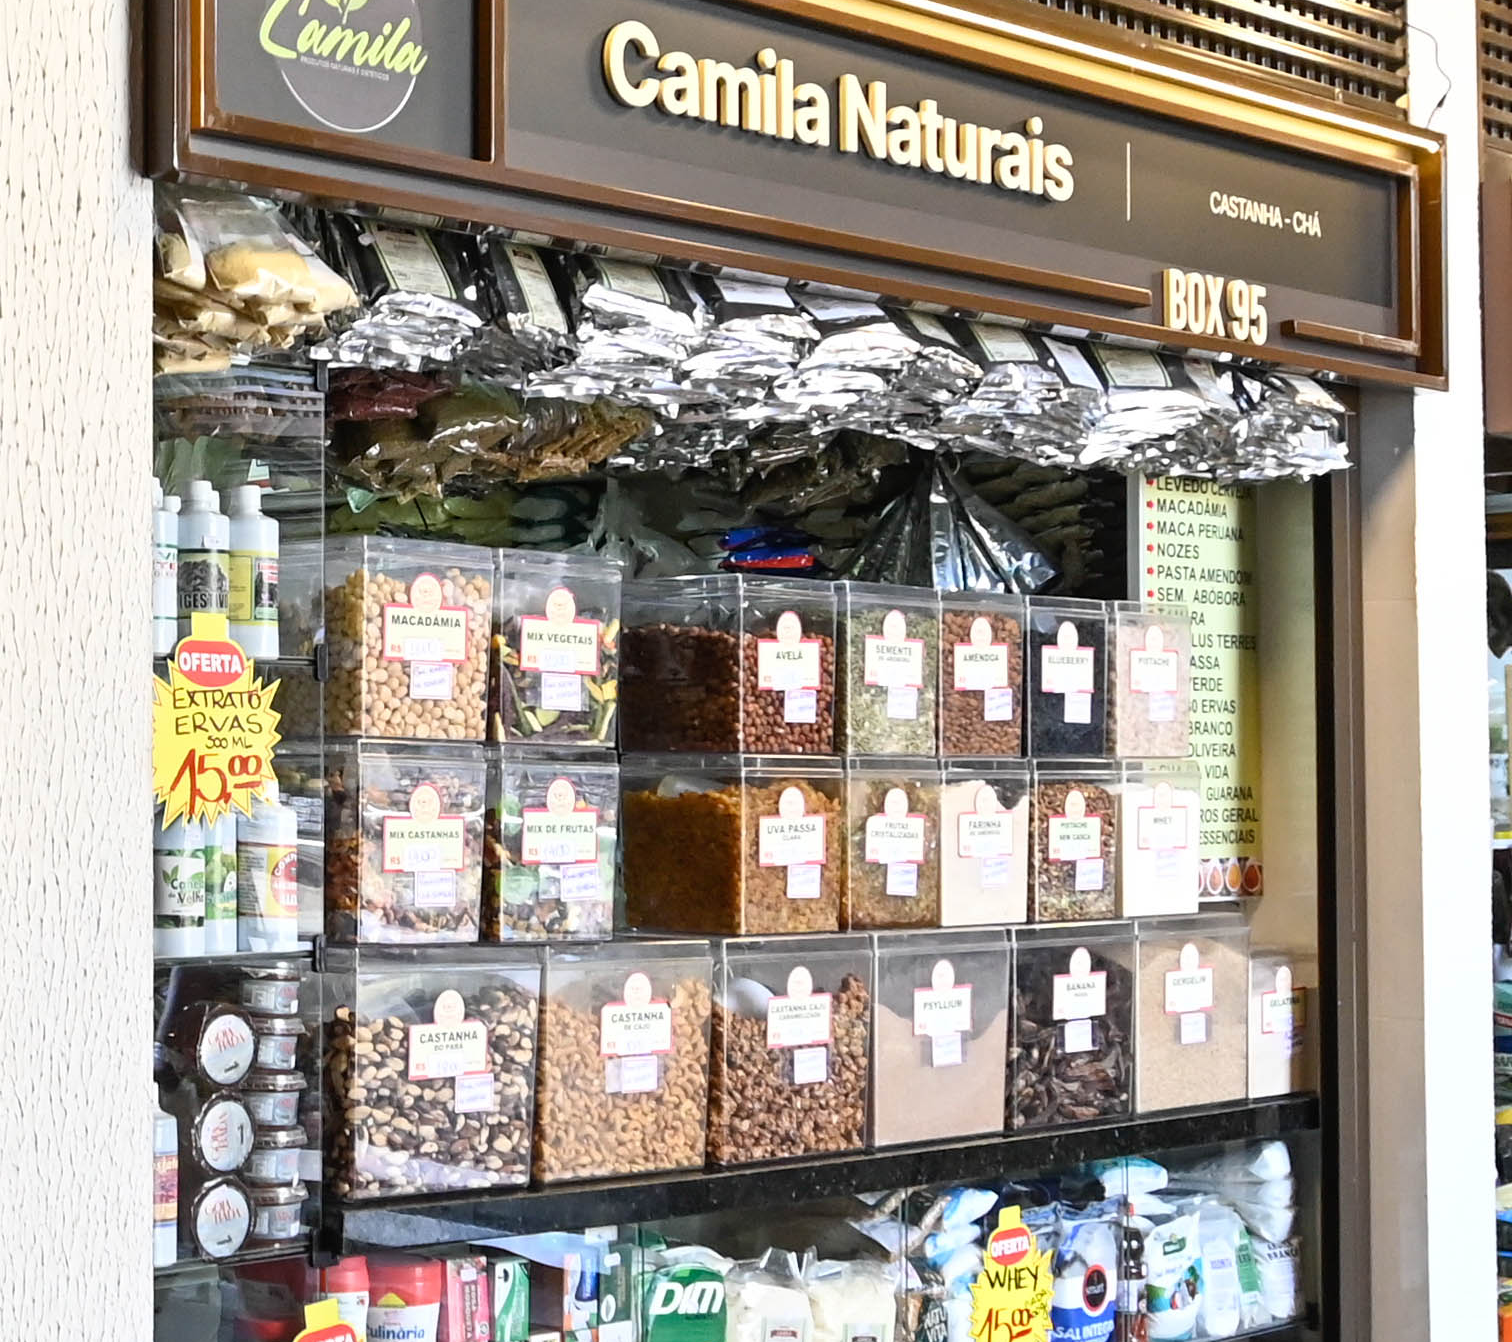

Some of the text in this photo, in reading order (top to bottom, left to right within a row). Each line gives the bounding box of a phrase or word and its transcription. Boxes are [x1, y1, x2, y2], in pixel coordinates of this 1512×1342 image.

[604, 20, 1074, 202] Camila Naturais
[1210, 191, 1322, 239] CASTANHA CHÁ
[1163, 268, 1268, 347] BOX 95
[1157, 475, 1208, 494] LEVEDO
[1157, 521, 1245, 542] MACA PERUANA
[1157, 543, 1200, 559] NOZES
[1157, 565, 1196, 581] PASTA
[179, 592, 229, 610] IGESTIV
[1193, 586, 1247, 606] ABÓBORA
[527, 632, 593, 645] MIX VEGETAIS
[178, 651, 243, 674] OFERTA
[1189, 655, 1220, 670] ASSA
[1189, 677, 1223, 692] ERDE
[173, 687, 262, 710] EXTRATO
[1202, 699, 1236, 714] ERVAS
[176, 712, 263, 735] ERVAS
[231, 736, 252, 748] ML
[1205, 765, 1229, 779] VIDA
[1222, 809, 1259, 823] GERAL
[389, 831, 460, 840] MIX CASTANHAS
[527, 824, 594, 833] MIX DE FRUTAS
[788, 824, 816, 833] PASSA
[611, 1010, 665, 1023] CASTANHA
[420, 1030, 478, 1044] CASTANHA
[991, 1235, 1031, 1258] OFERTA
[984, 1265, 1039, 1292] WHEY
[1054, 1326, 1081, 1341] SAL
